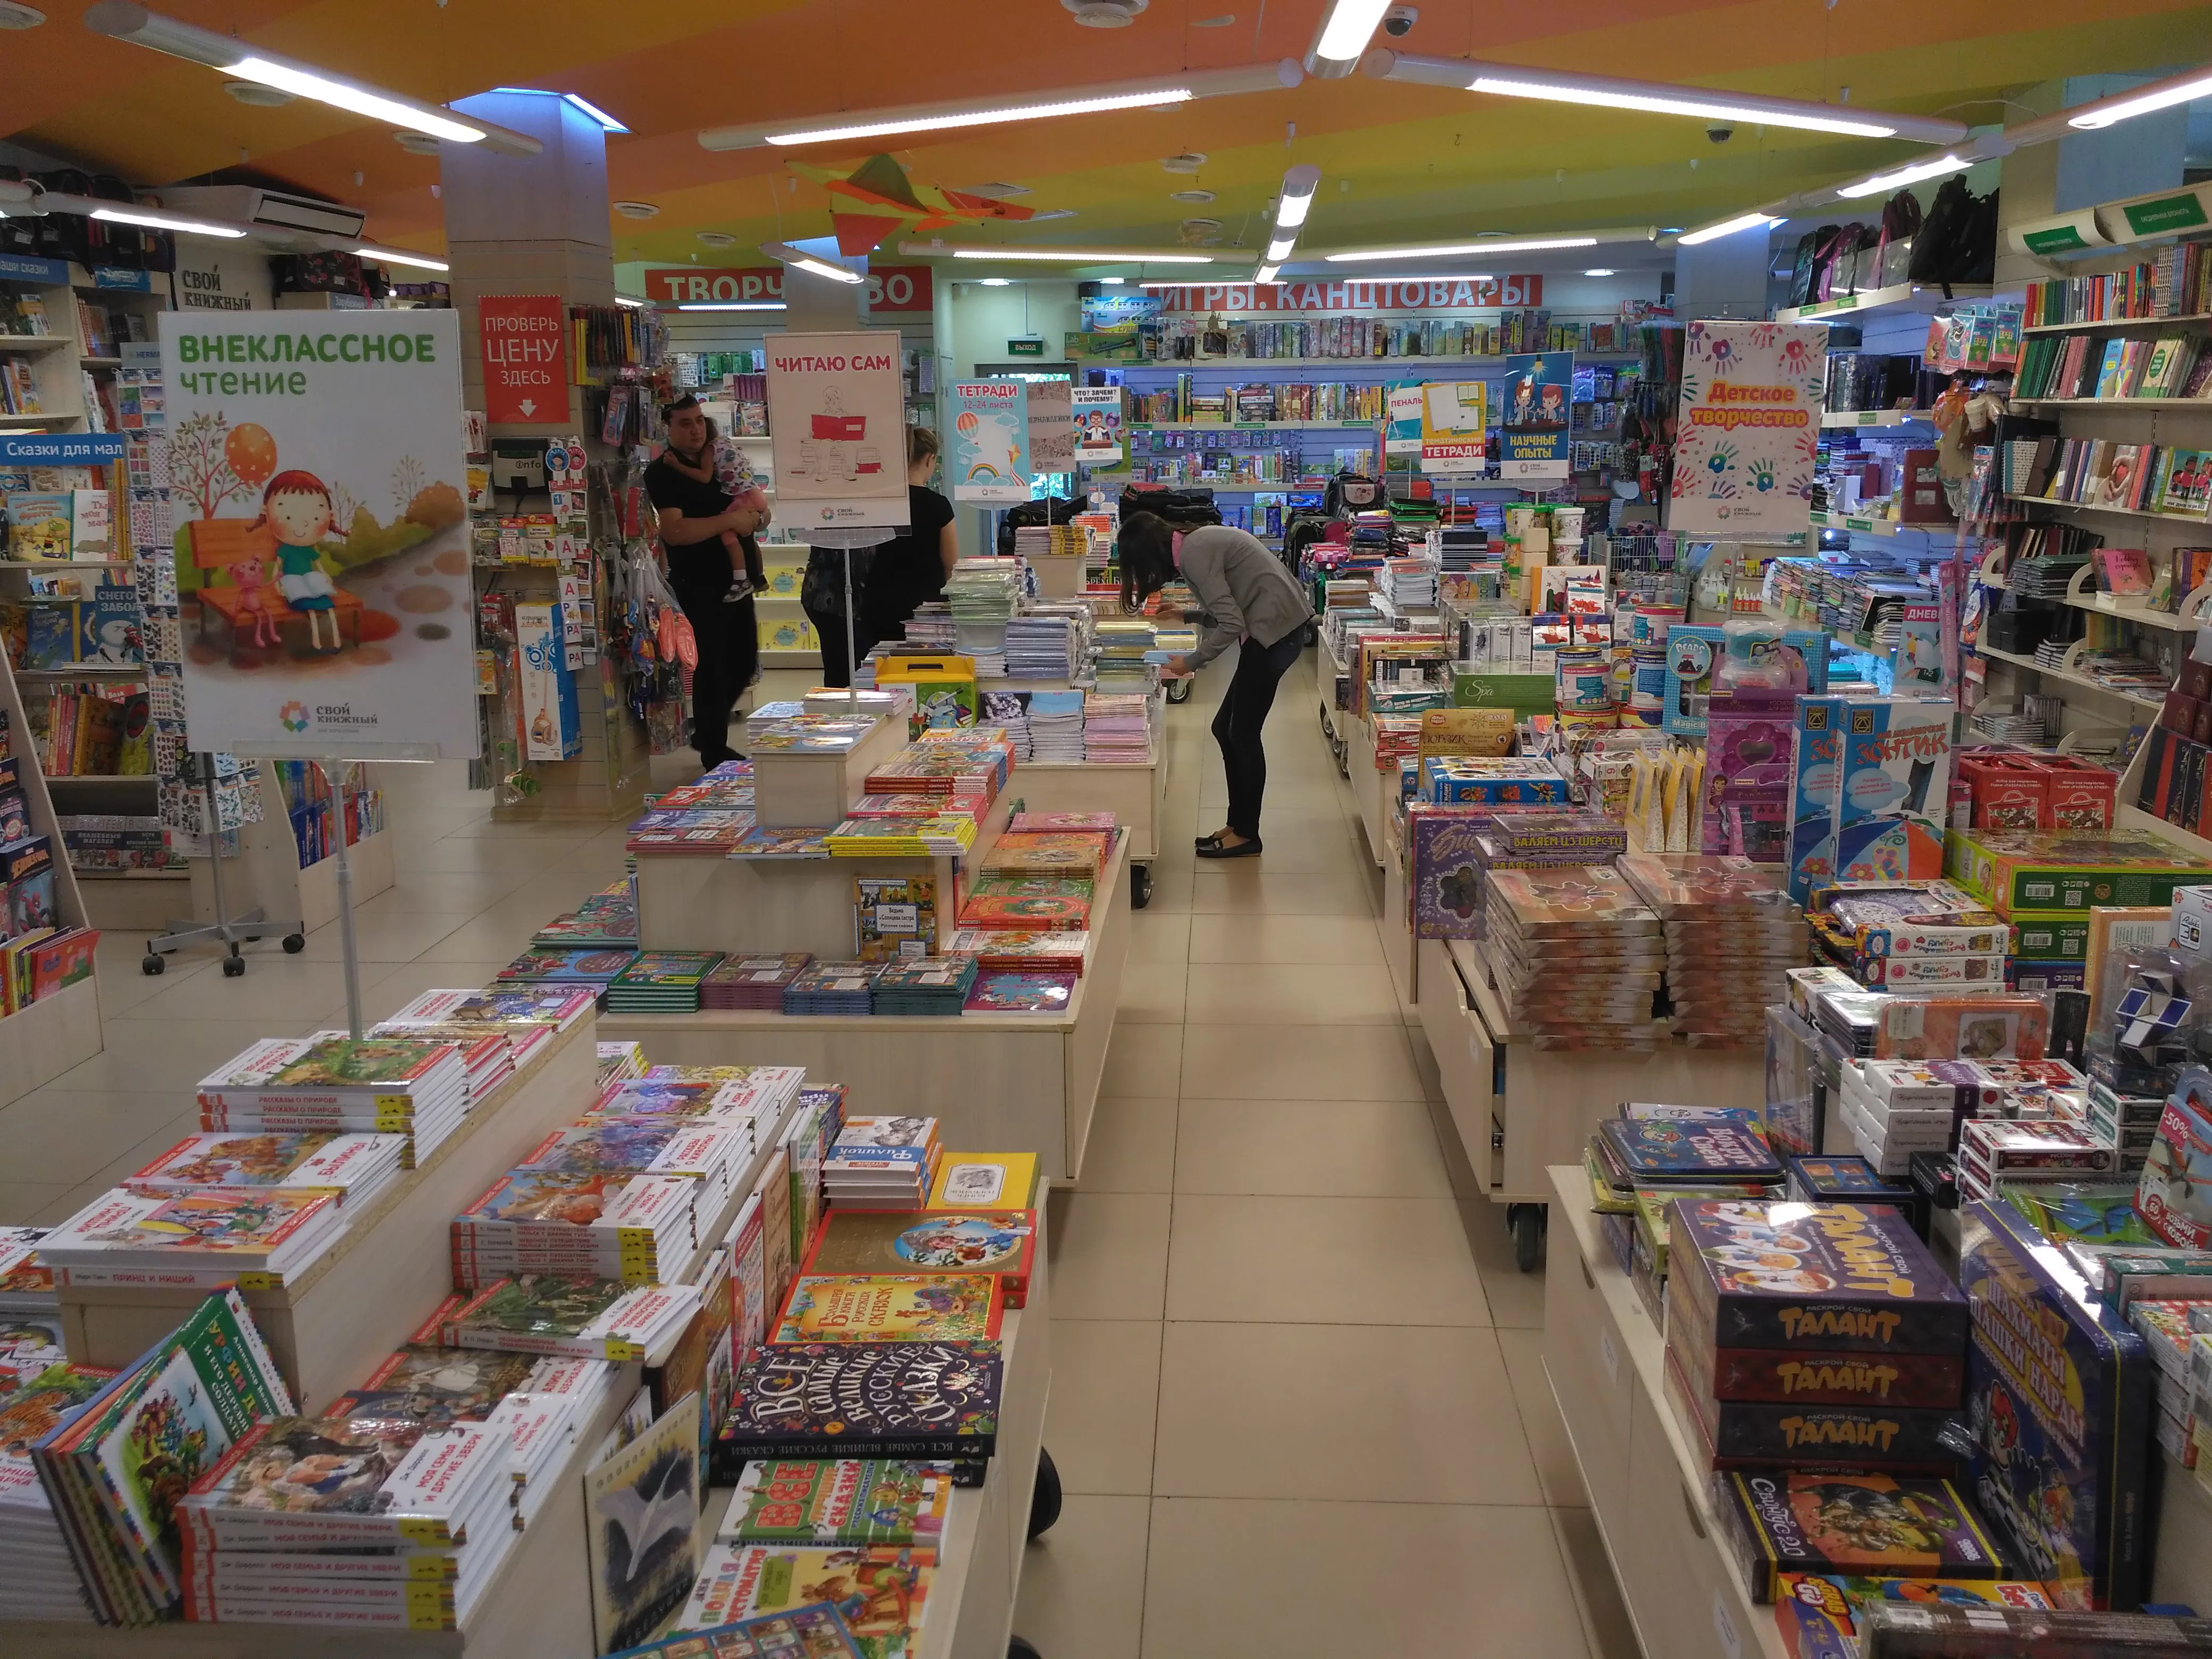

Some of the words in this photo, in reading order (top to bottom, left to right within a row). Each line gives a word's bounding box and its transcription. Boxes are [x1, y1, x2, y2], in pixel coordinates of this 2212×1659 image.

[182, 265, 221, 291] СВОЙ
[185, 292, 252, 310] КНИЖНЫЙ
[1278, 277, 1530, 309] КАНЦТОВАРЫ
[485, 317, 558, 331] ПРОВЕРЬ
[179, 334, 435, 363] ВНЕКЛАССНОЕ
[487, 338, 559, 367] ЦЕНУ
[775, 355, 846, 372] ЧИТАЮ
[851, 355, 891, 371] САМ
[180, 372, 307, 395] чтение
[501, 371, 550, 387] ЗДЕСЬ
[957, 385, 1018, 399] ТЕТРАДИ
[1708, 382, 1795, 403] Детское
[1692, 410, 1808, 430] творчество
[7, 442, 59, 456] Сказки
[63, 446, 90, 457] для
[1425, 436, 1481, 445] тематические
[1510, 435, 1557, 446] НАУЧНЫЕ
[1426, 446, 1482, 458] ТЕТРАДИ
[1514, 447, 1552, 458] ОПЫТЫ
[1675, 642, 1705, 654] BEADS
[1465, 680, 1493, 702] Spa
[316, 702, 350, 715] СВОЙ
[318, 714, 378, 724] КНИЖНЫЙ
[1673, 720, 1700, 728] Magic
[1856, 732, 1949, 765] ЗОНТИК
[1513, 837, 1558, 847] ВАЛЯЕМ
[1560, 837, 1575, 847] ИЗ
[1578, 836, 1623, 847] ШЕРСТИ
[2163, 1111, 2190, 1140] -50%
[317, 1141, 368, 1178] БЫЛИНЫ
[840, 1146, 908, 1160] Филипок
[1811, 1204, 1915, 1298] ТАЛАНТ
[1868, 1224, 1904, 1256] РАСКРОЙ
[1895, 1252, 1913, 1275] СВОЙ
[113, 1274, 146, 1283] ПРИНЦ
[158, 1273, 195, 1283] НИЩИЙ
[852, 1290, 872, 1323] РУССКИХ
[867, 1287, 894, 1327] СКАЗОК
[1778, 1306, 1901, 1344] ТАЛАНТ
[750, 1355, 819, 1422] ВСЕ
[1777, 1362, 1899, 1398] ТАЛАНТ
[1779, 1416, 1900, 1452] ТАЛАНТ
[430, 1444, 457, 1470] СЕМЬЯ
[731, 1446, 774, 1455] СКАЗКИ
[778, 1445, 828, 1454] РУССКИЕ
[832, 1444, 881, 1453] ВЕЛИКИЕ
[885, 1443, 926, 1452] САМЫЕ
[931, 1443, 953, 1451] ВСЕ
[434, 1461, 464, 1494] ДРУГИЕ
[755, 1462, 817, 1528] ВСЕ
[827, 1462, 864, 1528] СКАЗКИ
[1778, 1535, 1808, 1559] 2.0
